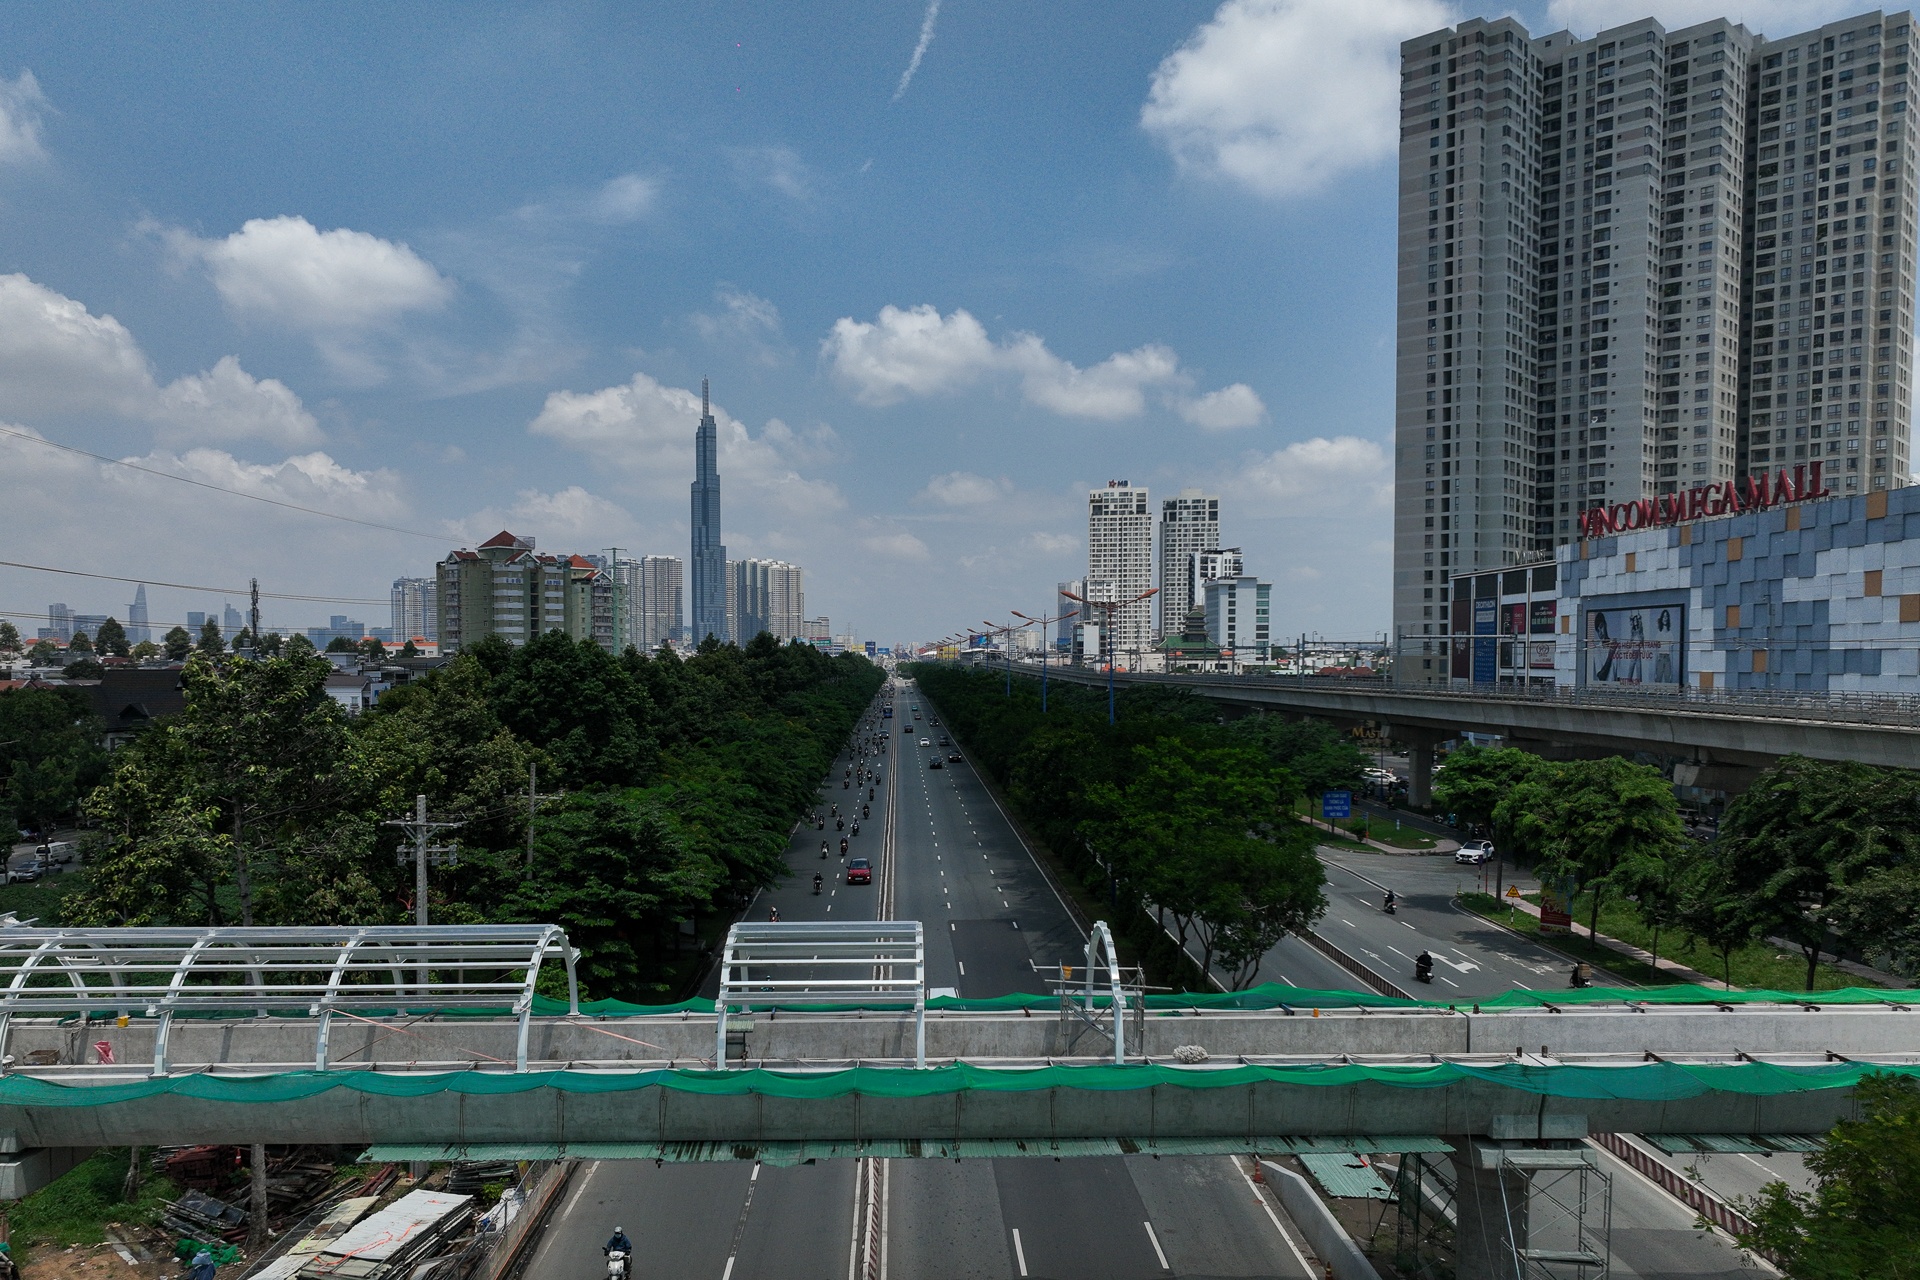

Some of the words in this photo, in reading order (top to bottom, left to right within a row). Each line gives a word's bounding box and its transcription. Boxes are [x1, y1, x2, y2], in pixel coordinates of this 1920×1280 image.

[1580, 496, 1661, 537] VINCOM
[1667, 480, 1740, 524] MEGA
[1745, 461, 1830, 510] MALL
[1475, 600, 1495, 609] DECATHLON
[1352, 727, 1382, 738] MAST
